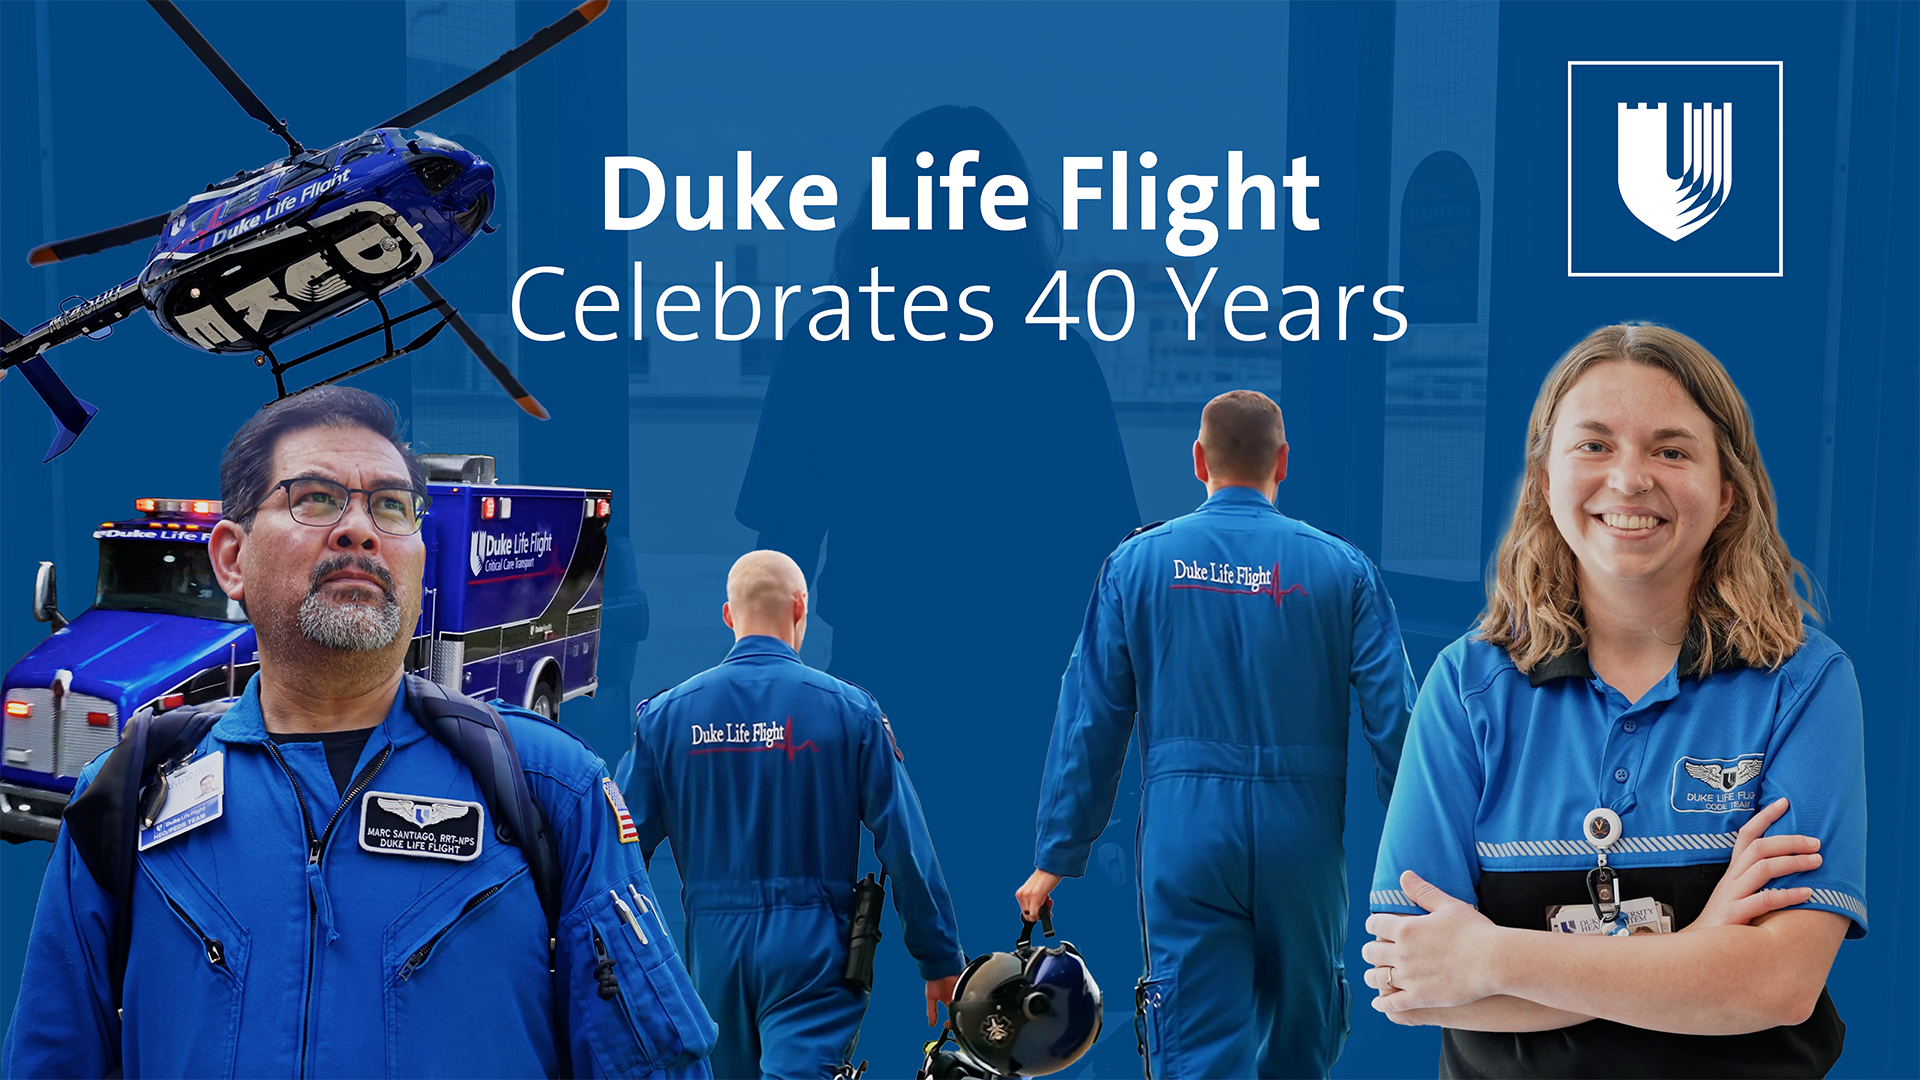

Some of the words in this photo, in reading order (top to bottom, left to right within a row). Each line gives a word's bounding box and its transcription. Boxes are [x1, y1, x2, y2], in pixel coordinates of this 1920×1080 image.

[211, 215, 261, 248] Duke
[265, 196, 297, 220] Life
[1410, 204, 1470, 223] CAUTION
[174, 222, 403, 350] DUKE
[106, 529, 157, 539] Duke
[160, 531, 197, 541] Life
[486, 532, 512, 556] Duke
[514, 532, 529, 554] Life
[530, 531, 552, 558] Flight
[485, 558, 502, 572] Critical
[503, 558, 514, 570] Care
[515, 557, 535, 571] Transport
[1173, 559, 1208, 580] Duke
[1210, 562, 1234, 584] Life
[1236, 566, 1271, 592] Flight
[691, 723, 724, 745] Duke
[726, 723, 750, 743] Life
[752, 721, 784, 748] Flight
[1687, 792, 1714, 802] DUKE
[1717, 792, 1735, 802] LIFE
[1705, 802, 1727, 811] CODE
[1730, 801, 1750, 809] TEAM
[153, 821, 187, 840] NEO/PEDS
[188, 813, 206, 825] TEAM
[165, 817, 181, 828] Duke
[367, 827, 391, 838] MARC
[393, 829, 437, 843] SANTIAGO,
[440, 834, 475, 847] RRT-NPS
[380, 838, 404, 849] DUKE
[406, 840, 426, 851] LIFE
[428, 842, 461, 854] FLIGHT
[1580, 918, 1600, 927] DUK
[1581, 923, 1600, 932] HEA
